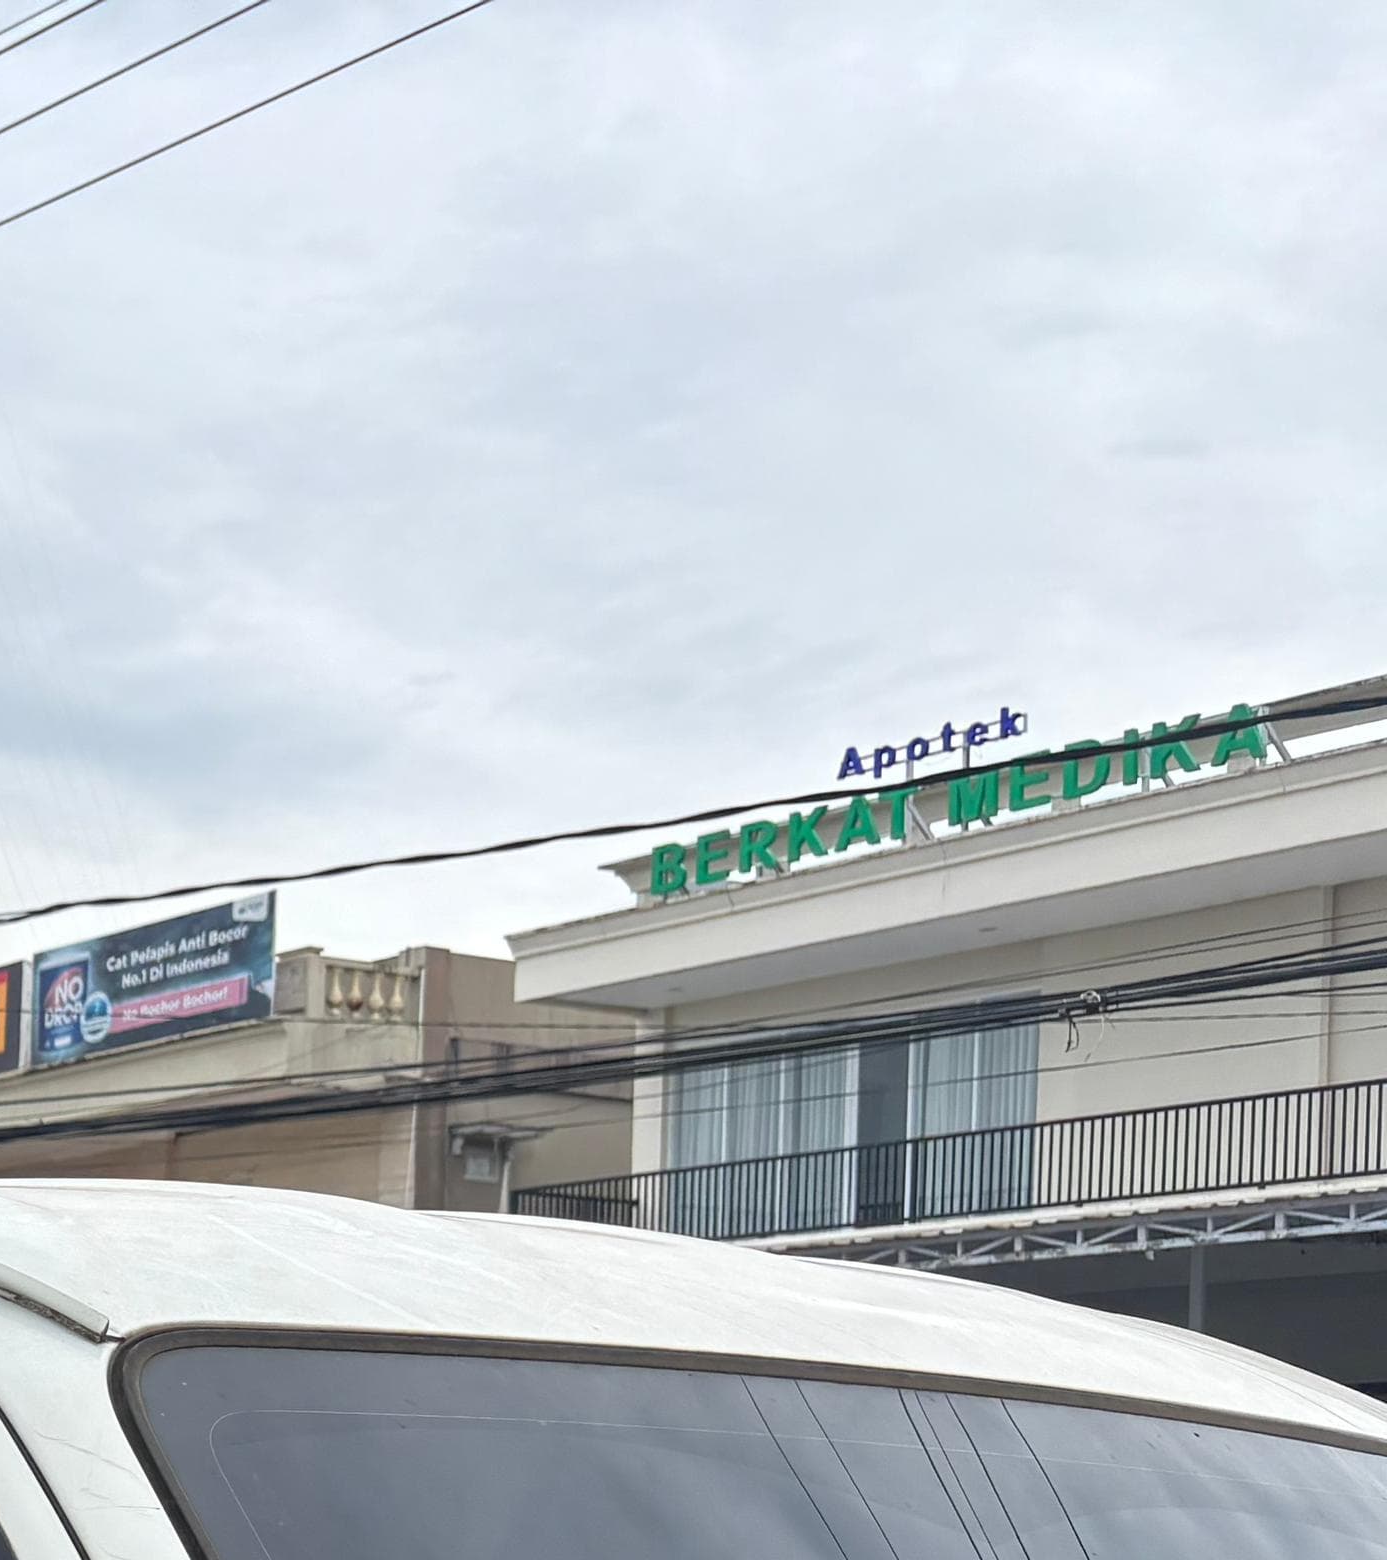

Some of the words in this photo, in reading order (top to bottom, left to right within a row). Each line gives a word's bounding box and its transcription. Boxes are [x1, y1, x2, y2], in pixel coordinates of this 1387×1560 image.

[837, 707, 1024, 780] Apotek
[650, 786, 918, 896] BERKAT
[948, 703, 1268, 829] MEDIKA
[106, 954, 126, 973] Cat
[131, 940, 177, 966] Pelapis
[178, 931, 206, 954] Anti
[209, 925, 248, 947] Bocor
[150, 966, 164, 982] Di
[166, 948, 230, 977] Indonesia
[55, 976, 84, 1006] NO
